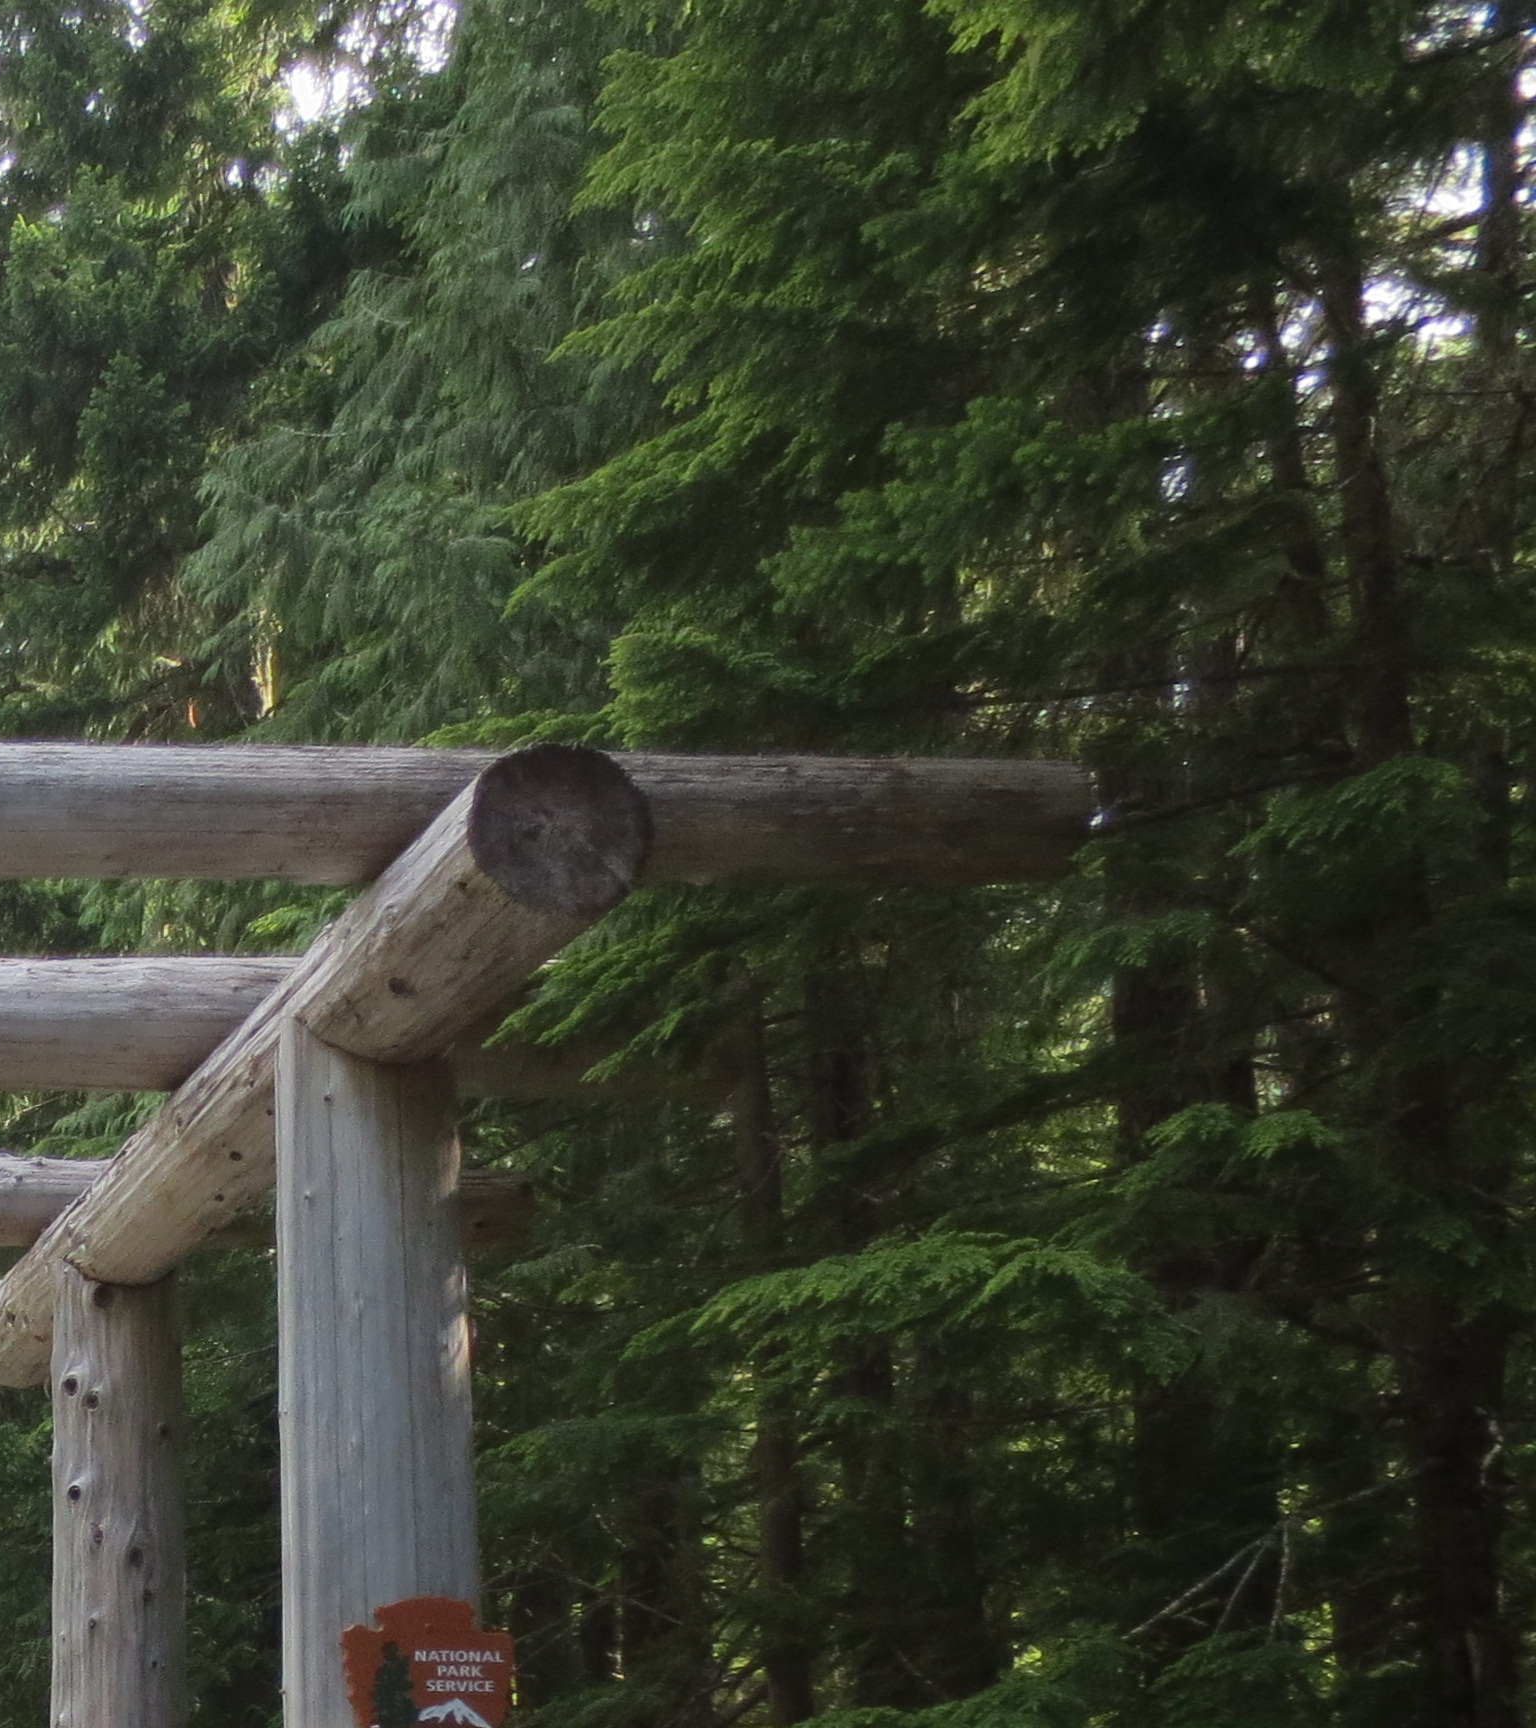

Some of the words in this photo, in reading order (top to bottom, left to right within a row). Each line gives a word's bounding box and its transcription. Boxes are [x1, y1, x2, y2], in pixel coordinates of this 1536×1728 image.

[414, 1650, 503, 1662] NATIONAL
[437, 1665, 483, 1677] PARK
[426, 1680, 495, 1692] SERVICE
